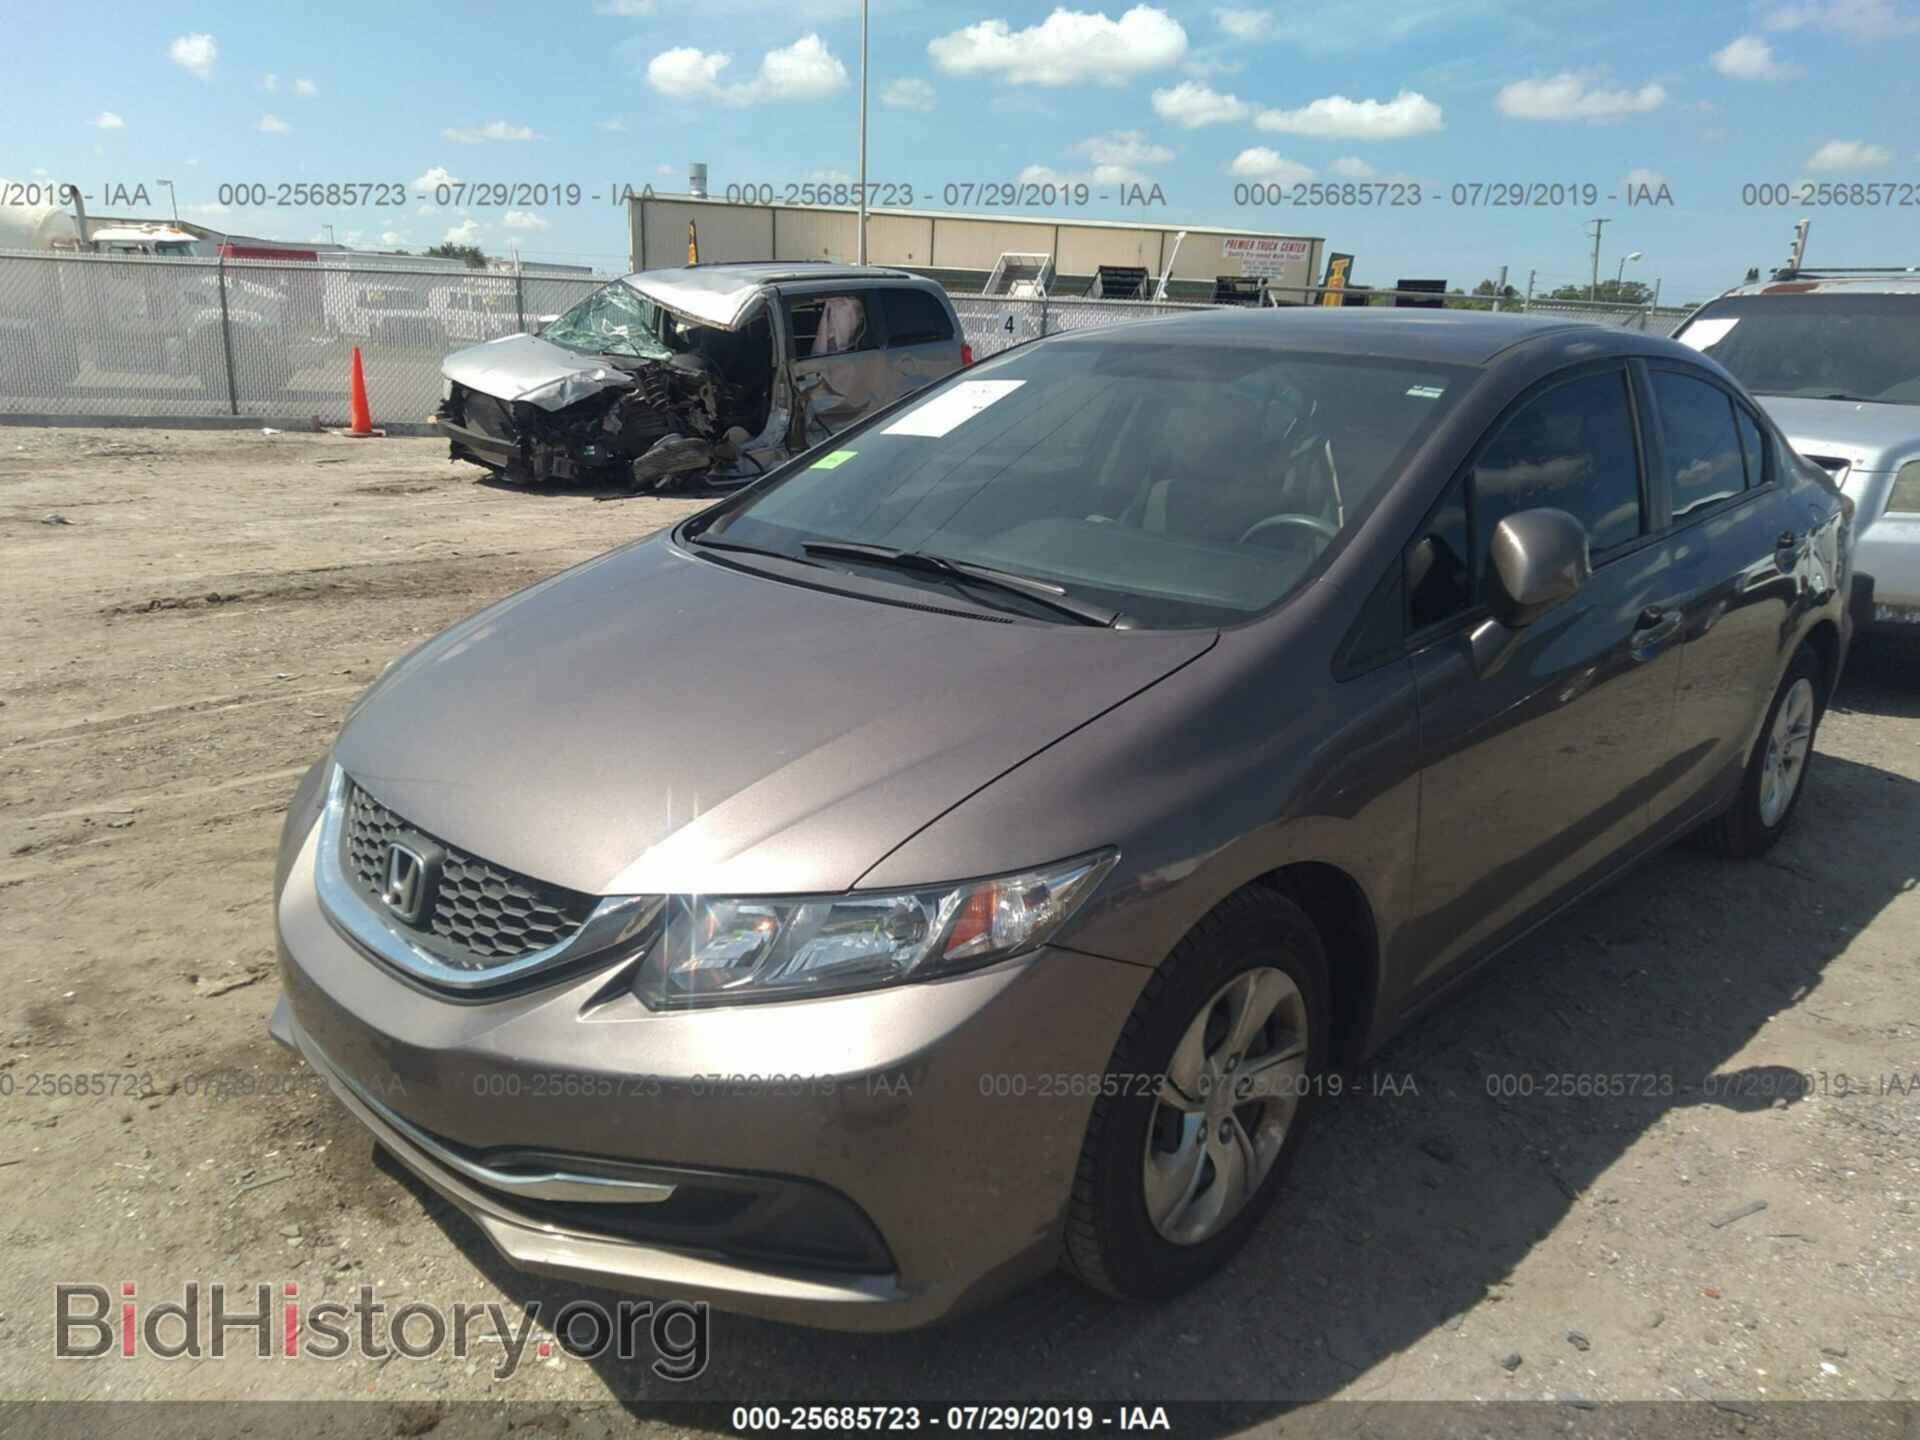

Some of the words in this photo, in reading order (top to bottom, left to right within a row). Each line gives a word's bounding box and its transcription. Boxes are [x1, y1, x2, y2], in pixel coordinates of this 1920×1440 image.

[1225, 239, 1255, 250] PREMIER
[1256, 240, 1279, 251] TRUCK
[1280, 241, 1307, 253] CENTER
[1004, 315, 1015, 334] 4
